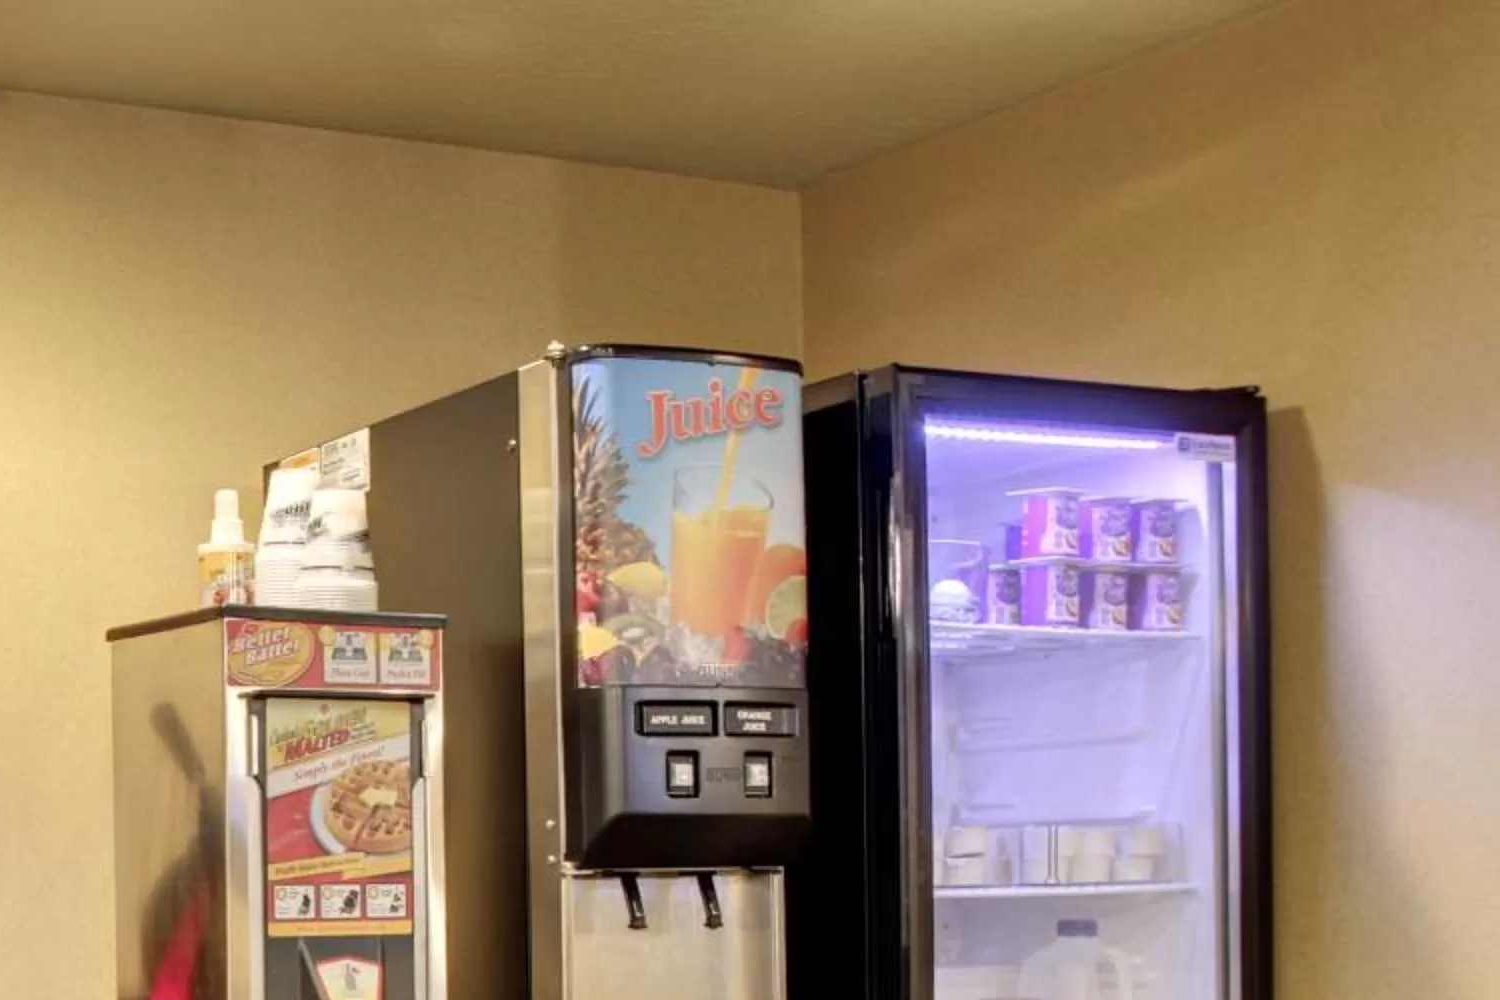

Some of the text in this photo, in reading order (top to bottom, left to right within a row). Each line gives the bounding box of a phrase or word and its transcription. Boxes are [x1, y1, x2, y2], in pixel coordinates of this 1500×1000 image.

[636, 376, 784, 458] Juice
[651, 715, 705, 725] APPLE JUICE
[737, 710, 772, 721] ORANGE
[743, 722, 767, 732] JUICE
